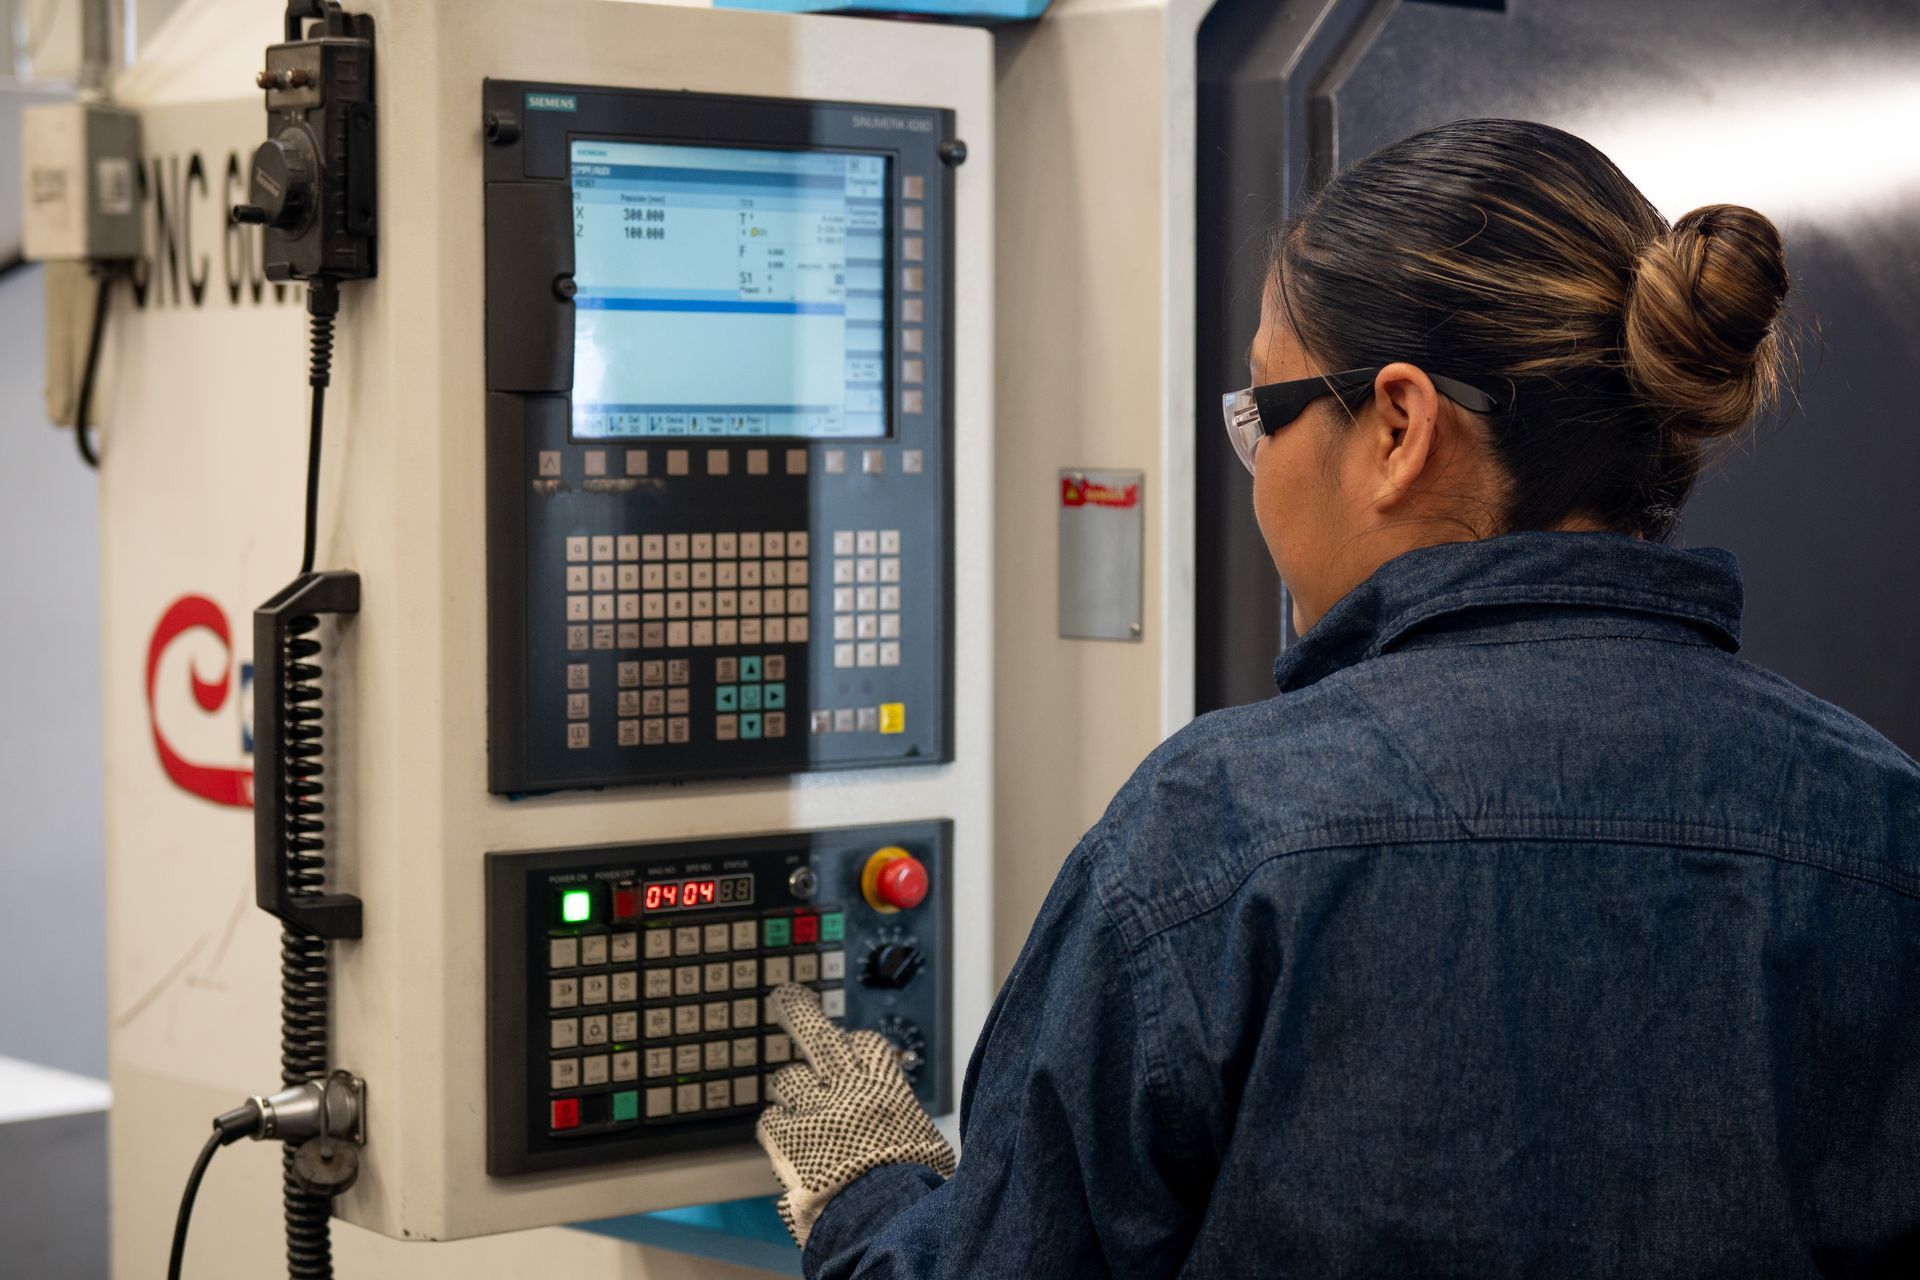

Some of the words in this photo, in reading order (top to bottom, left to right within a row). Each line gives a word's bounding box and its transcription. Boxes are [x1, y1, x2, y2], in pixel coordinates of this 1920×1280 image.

[528, 96, 575, 110] SIEMENS
[575, 205, 585, 219] X
[623, 207, 665, 222] 300.000
[575, 224, 584, 238] Z
[624, 226, 665, 240] 100.000
[548, 874, 576, 884] POWER
[594, 871, 621, 880] POWER
[645, 884, 678, 908] 04
[683, 880, 715, 905] 04
